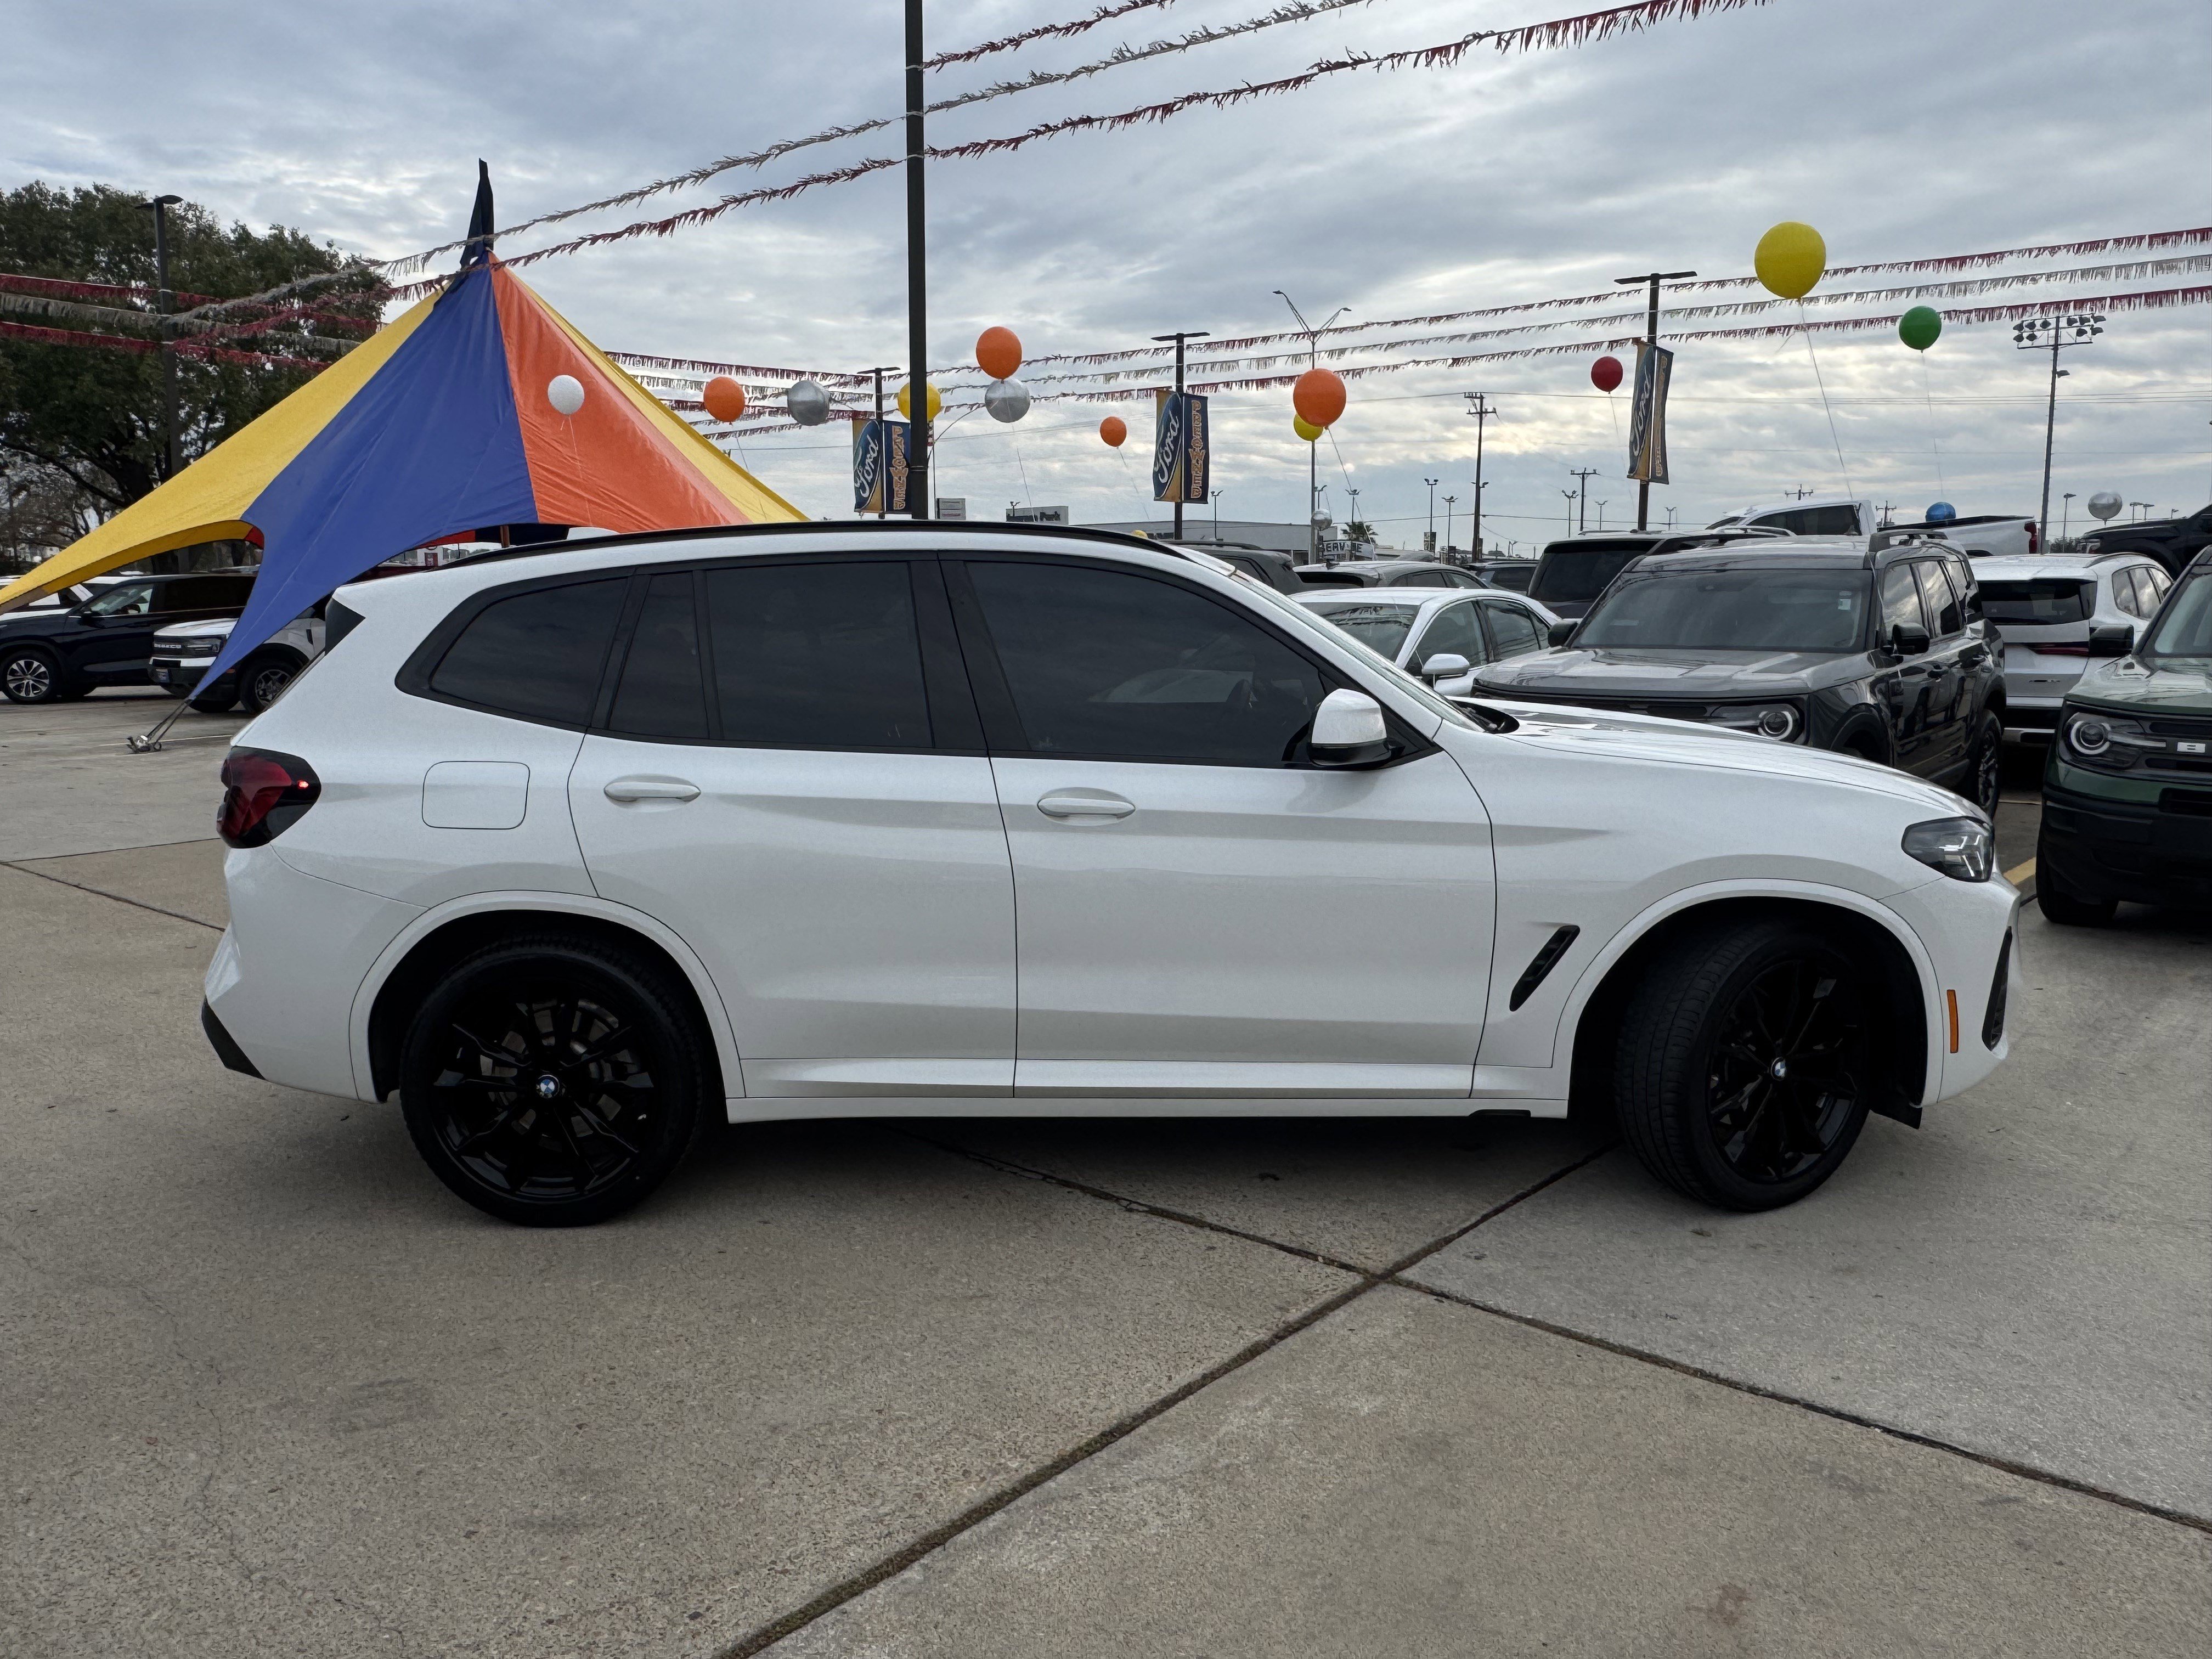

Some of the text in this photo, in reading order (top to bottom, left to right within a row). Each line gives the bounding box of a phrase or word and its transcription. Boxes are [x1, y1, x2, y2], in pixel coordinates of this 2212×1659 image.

[1154, 410, 1179, 483] Ford
[1630, 365, 1650, 456] Ford
[854, 434, 878, 498] Ford
